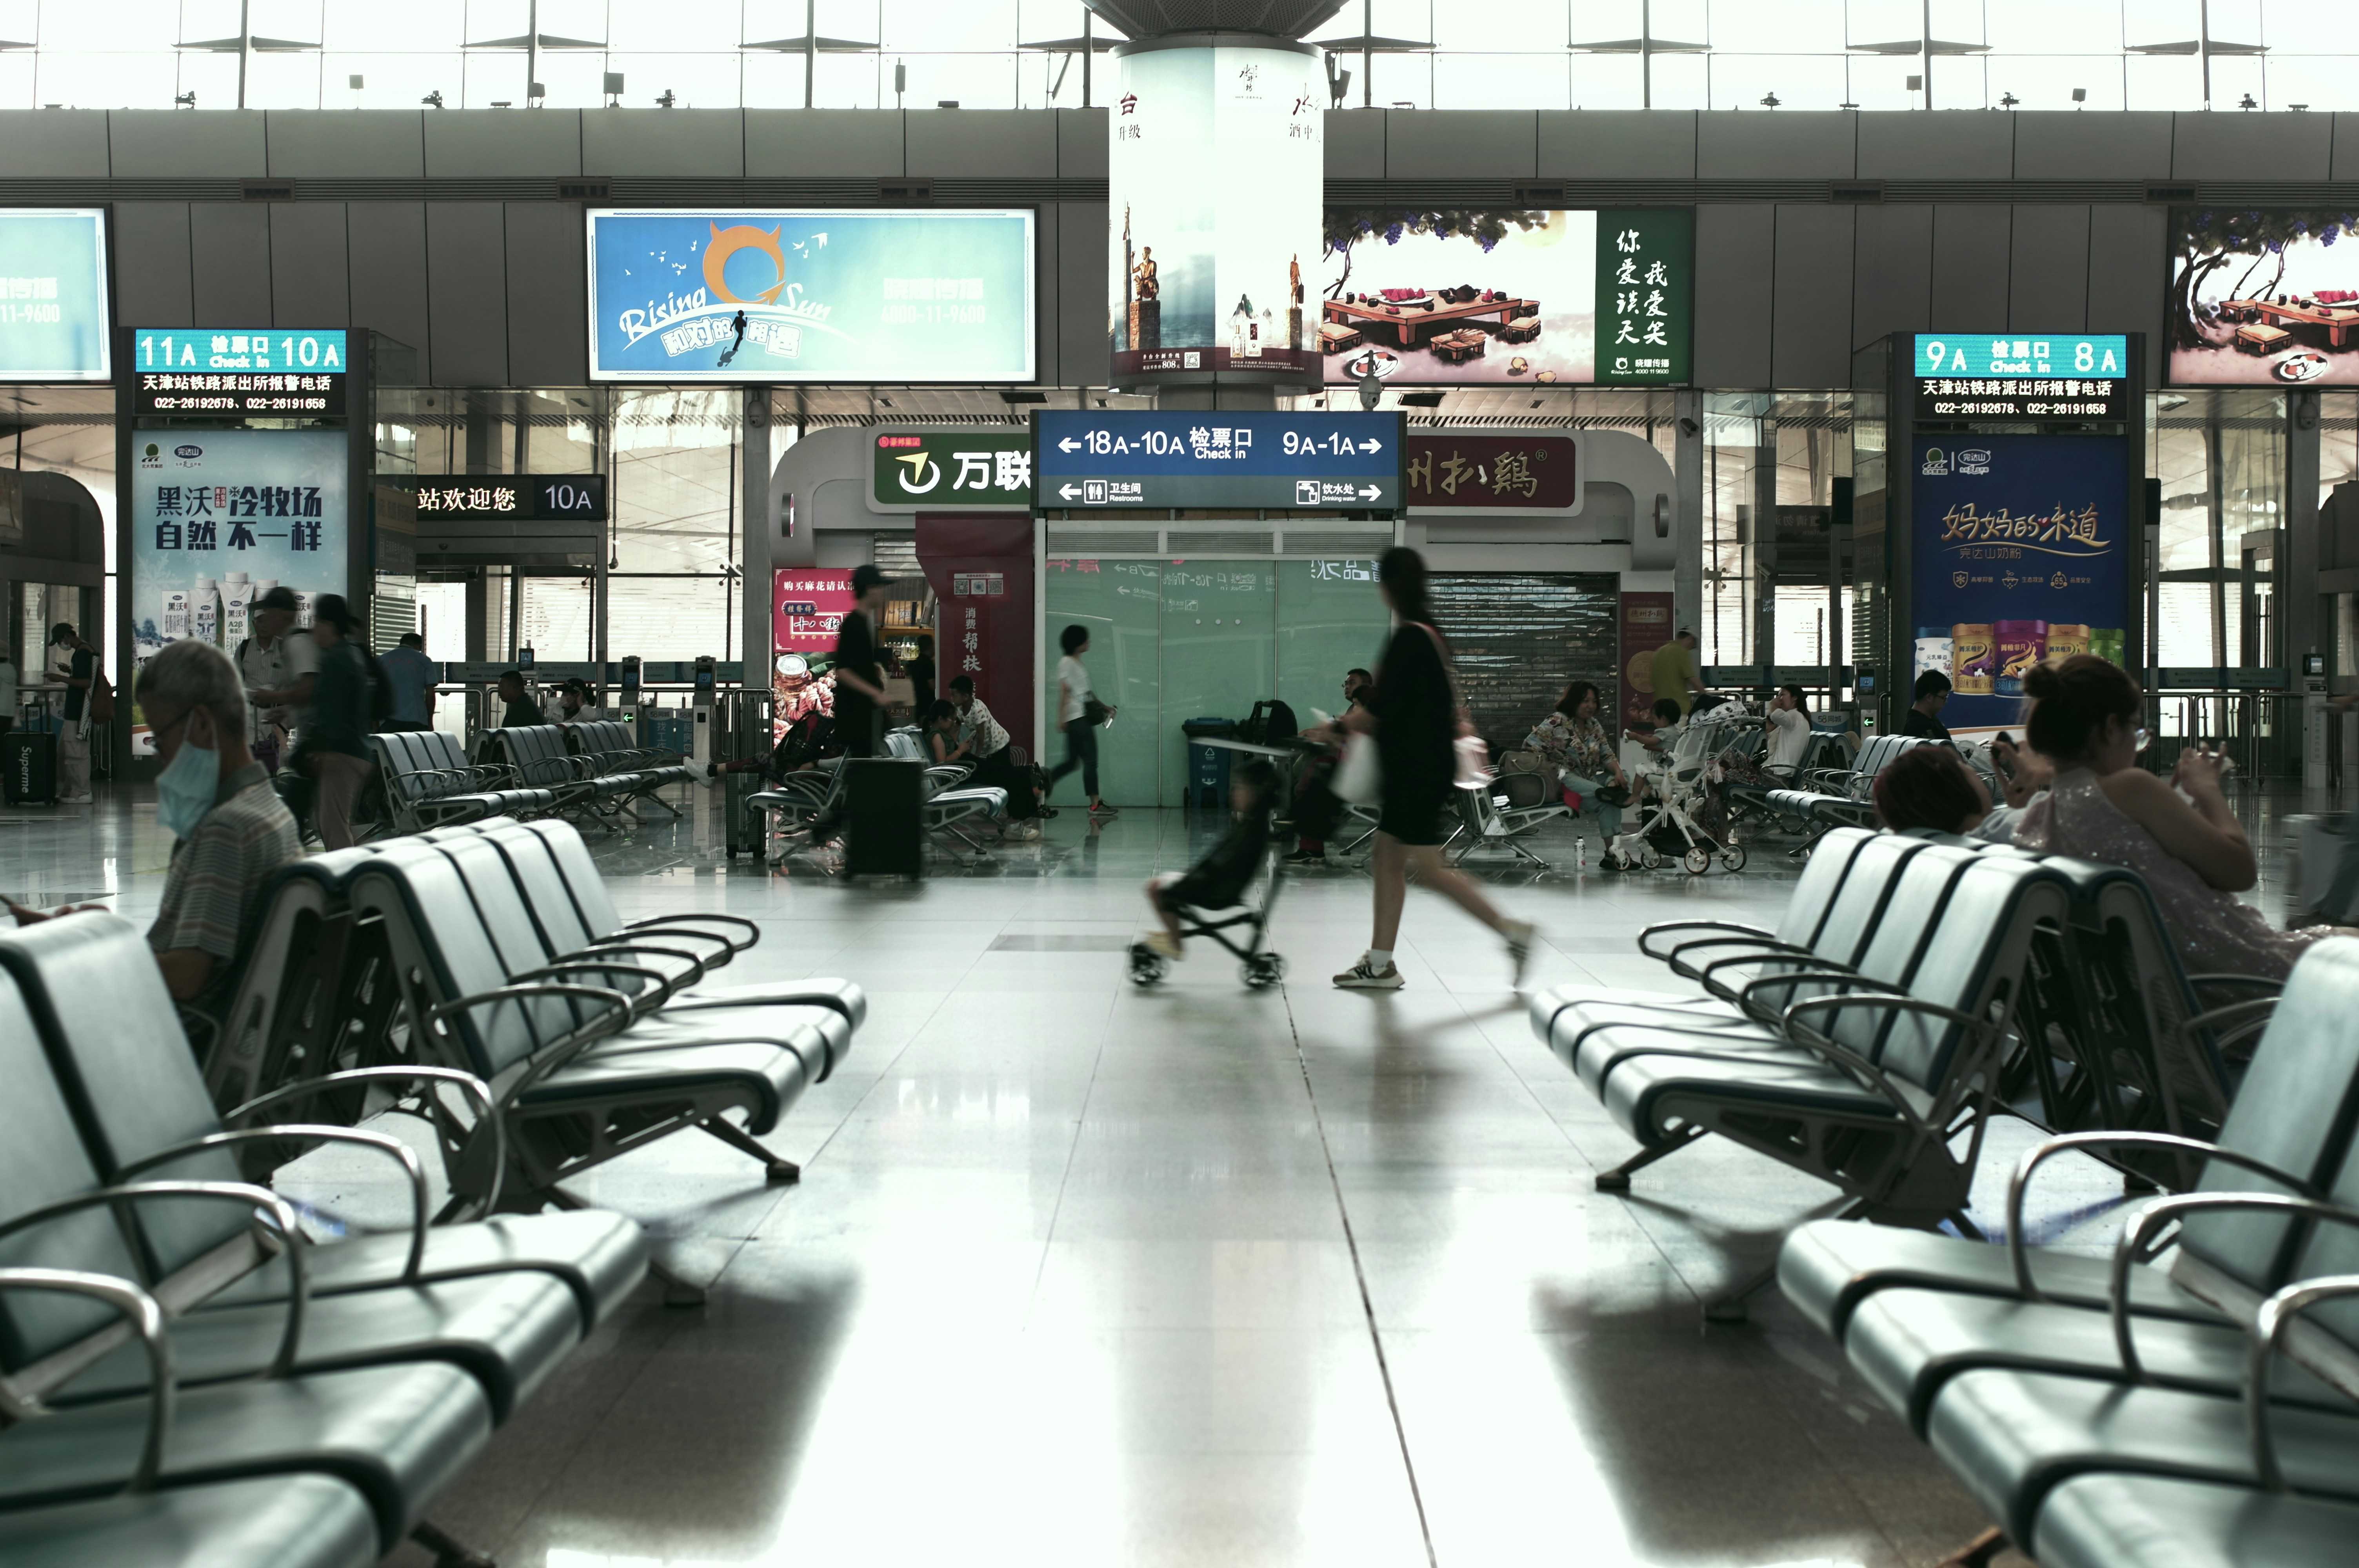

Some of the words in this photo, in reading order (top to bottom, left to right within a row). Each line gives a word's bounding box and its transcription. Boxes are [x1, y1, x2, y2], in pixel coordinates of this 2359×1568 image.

[1120, 91, 1138, 116] 台
[1293, 82, 1320, 116] 水
[1119, 124, 1141, 141] 升级
[1289, 123, 1320, 143] 酒中
[1615, 229, 1641, 345] 你爱谈天
[1643, 260, 1668, 346] 我爱笑
[619, 287, 706, 349] Rising
[777, 282, 831, 321] Sun
[211, 335, 269, 354] 检票口
[1992, 340, 2050, 358] 检票口
[209, 355, 251, 368] Check
[256, 355, 270, 368] in
[1990, 360, 2031, 373] Check
[2037, 361, 2050, 373] in
[143, 375, 332, 392] 天津站铁路派出所报警电话
[1923, 379, 2112, 396] 天津站铁路派出所报警电话
[1084, 430, 1185, 456] 18A-10A
[1189, 426, 1253, 448] 检票口
[1283, 431, 1356, 456] 9A-1A
[178, 447, 199, 456] 完达山
[1194, 446, 1233, 460] Check
[1235, 446, 1246, 459] in
[952, 450, 1030, 491] 万联
[545, 484, 592, 509] 10A
[1109, 483, 1141, 494] 卫生间
[1322, 483, 1354, 495] 饮水处
[156, 486, 213, 517] 黑沃
[229, 486, 322, 517] 冷牧场
[417, 487, 516, 511] 站欢迎您
[1941, 500, 2111, 548] 妈妈的味道
[156, 520, 216, 551] 自然
[227, 521, 322, 551] 不一样
[1959, 547, 2022, 559] 完达山奶粉
[168, 602, 184, 611] 黑沃
[228, 610, 243, 618] 黑沃
[19, 746, 32, 793] Superme
